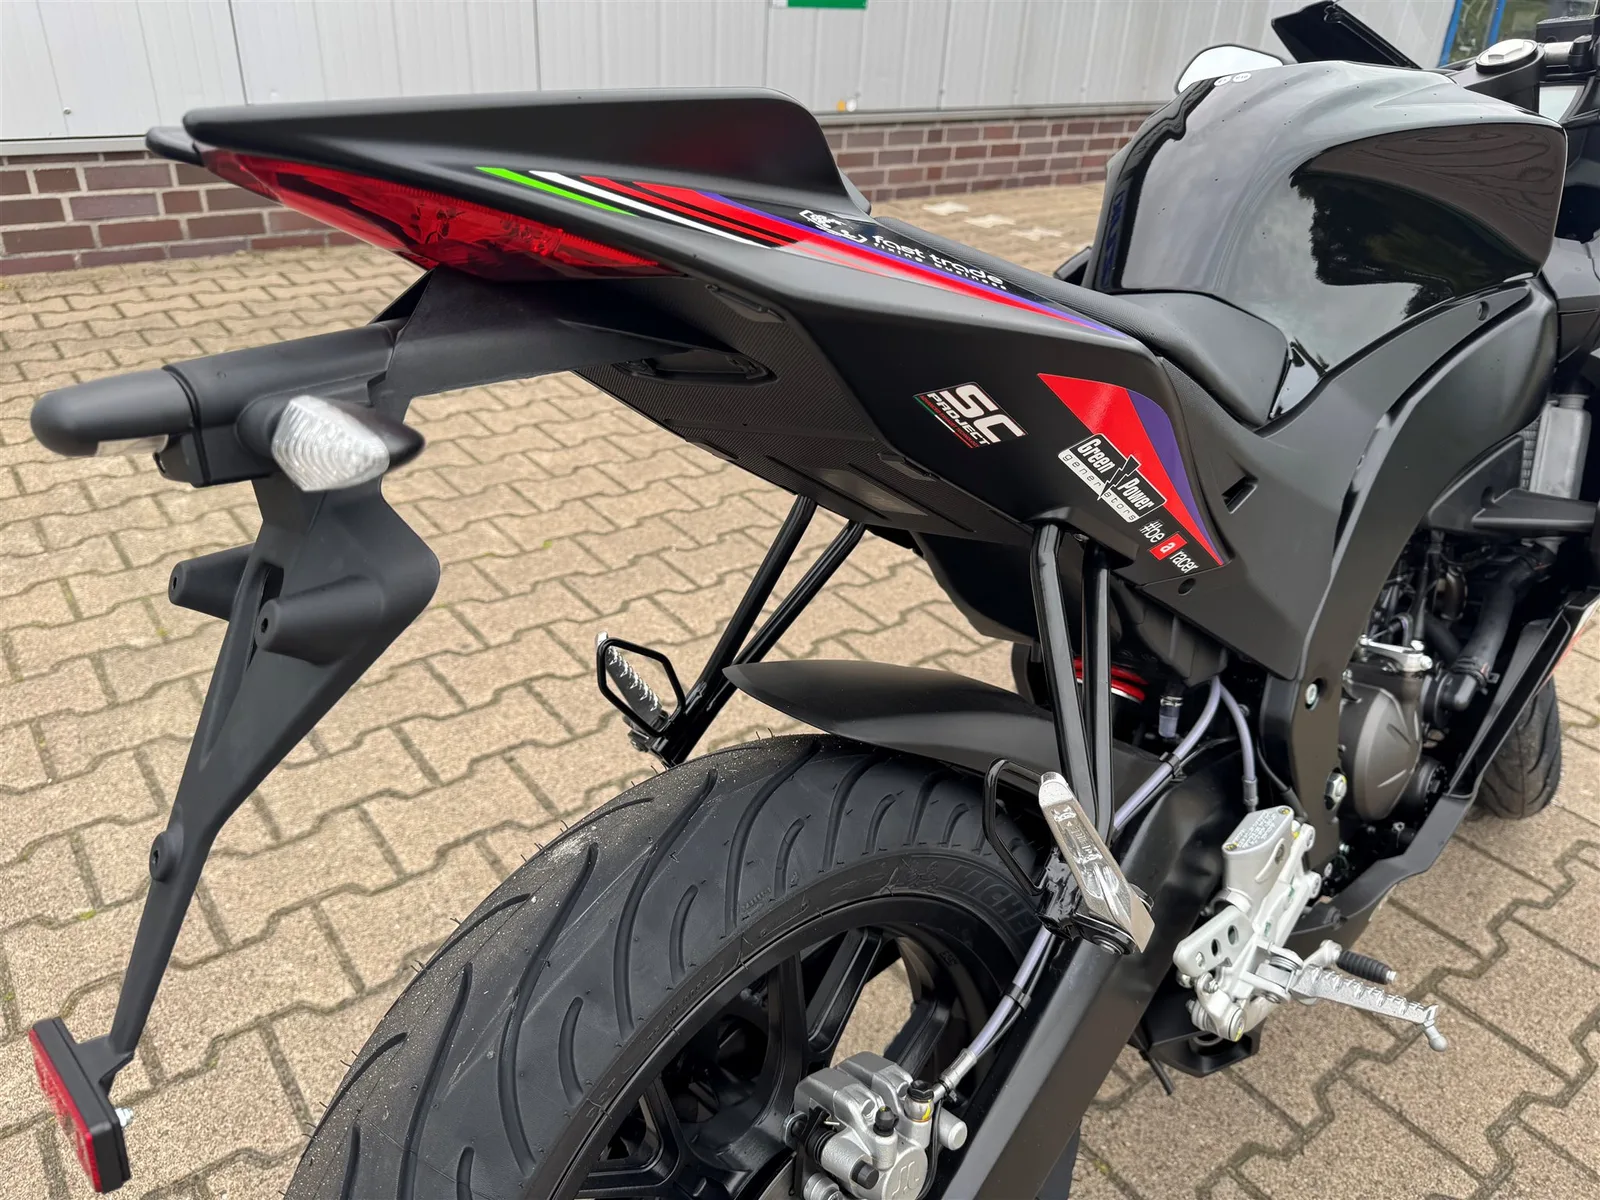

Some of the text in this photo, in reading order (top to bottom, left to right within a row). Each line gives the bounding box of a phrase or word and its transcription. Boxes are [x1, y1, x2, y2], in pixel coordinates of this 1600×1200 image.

[872, 235, 1003, 285] fast trade
[926, 392, 990, 445] PROJECT
[939, 384, 1026, 443] SC
[1062, 454, 1136, 521] generators
[1077, 438, 1155, 511] Green Power
[1139, 519, 1166, 544] #be
[1159, 541, 1176, 554] a
[1169, 550, 1199, 574] racer
